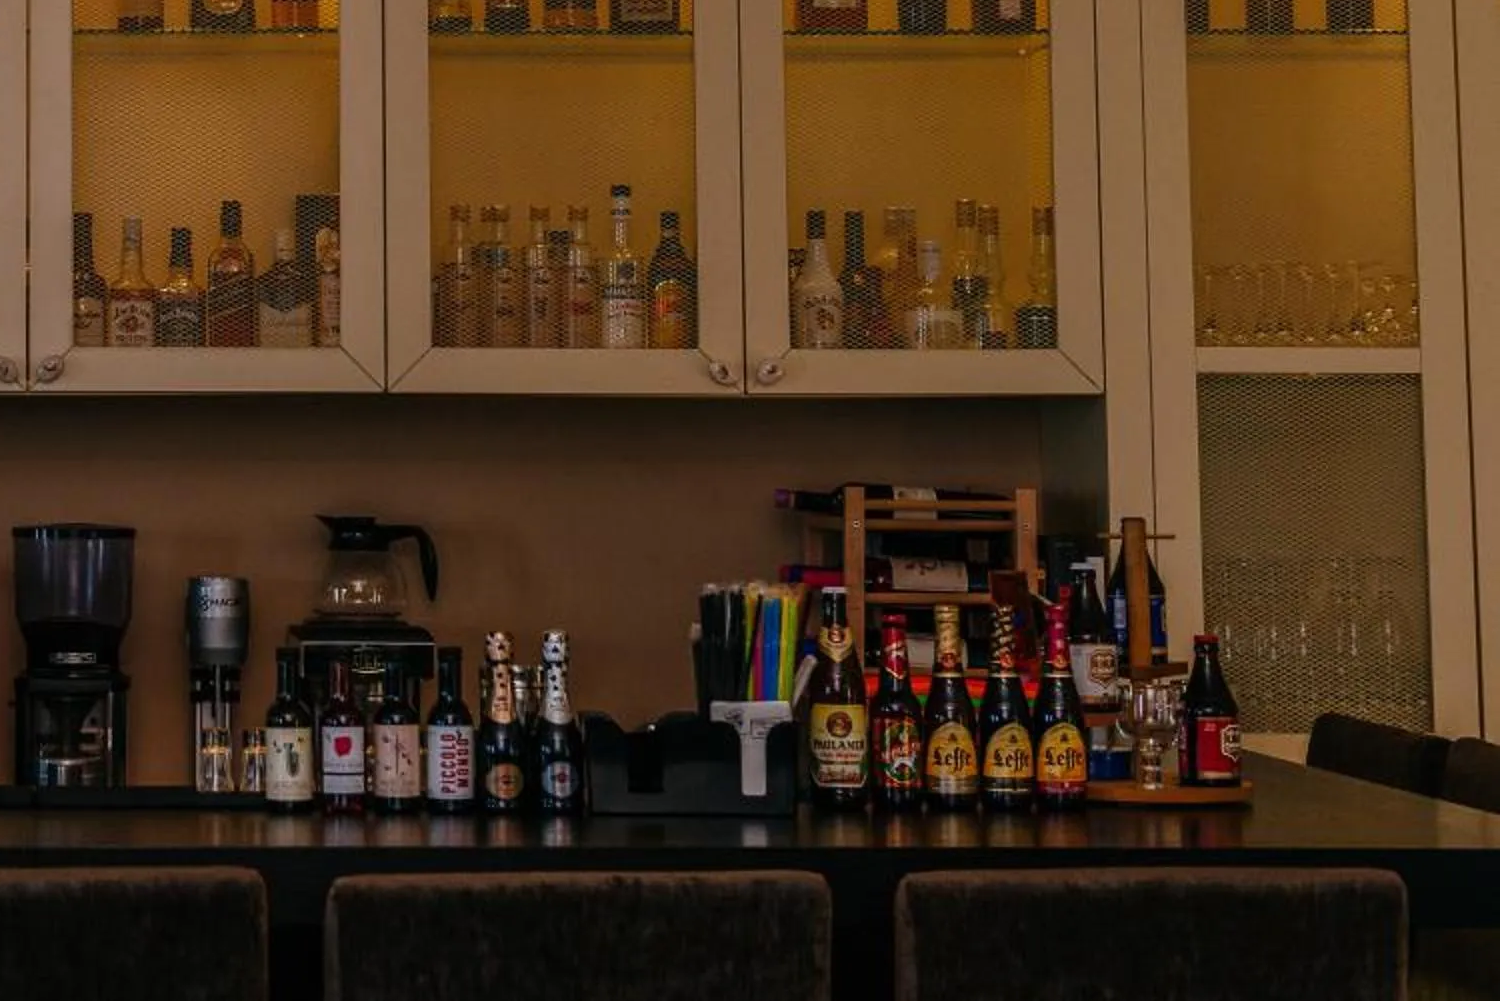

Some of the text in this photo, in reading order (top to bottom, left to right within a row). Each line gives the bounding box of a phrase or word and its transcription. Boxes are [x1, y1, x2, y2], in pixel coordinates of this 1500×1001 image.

[440, 734, 456, 794] PICCOLO
[456, 738, 469, 788] MONDO
[932, 747, 972, 772] Leffe
[993, 748, 1029, 772] Leffe
[1045, 748, 1084, 770] Leffe
